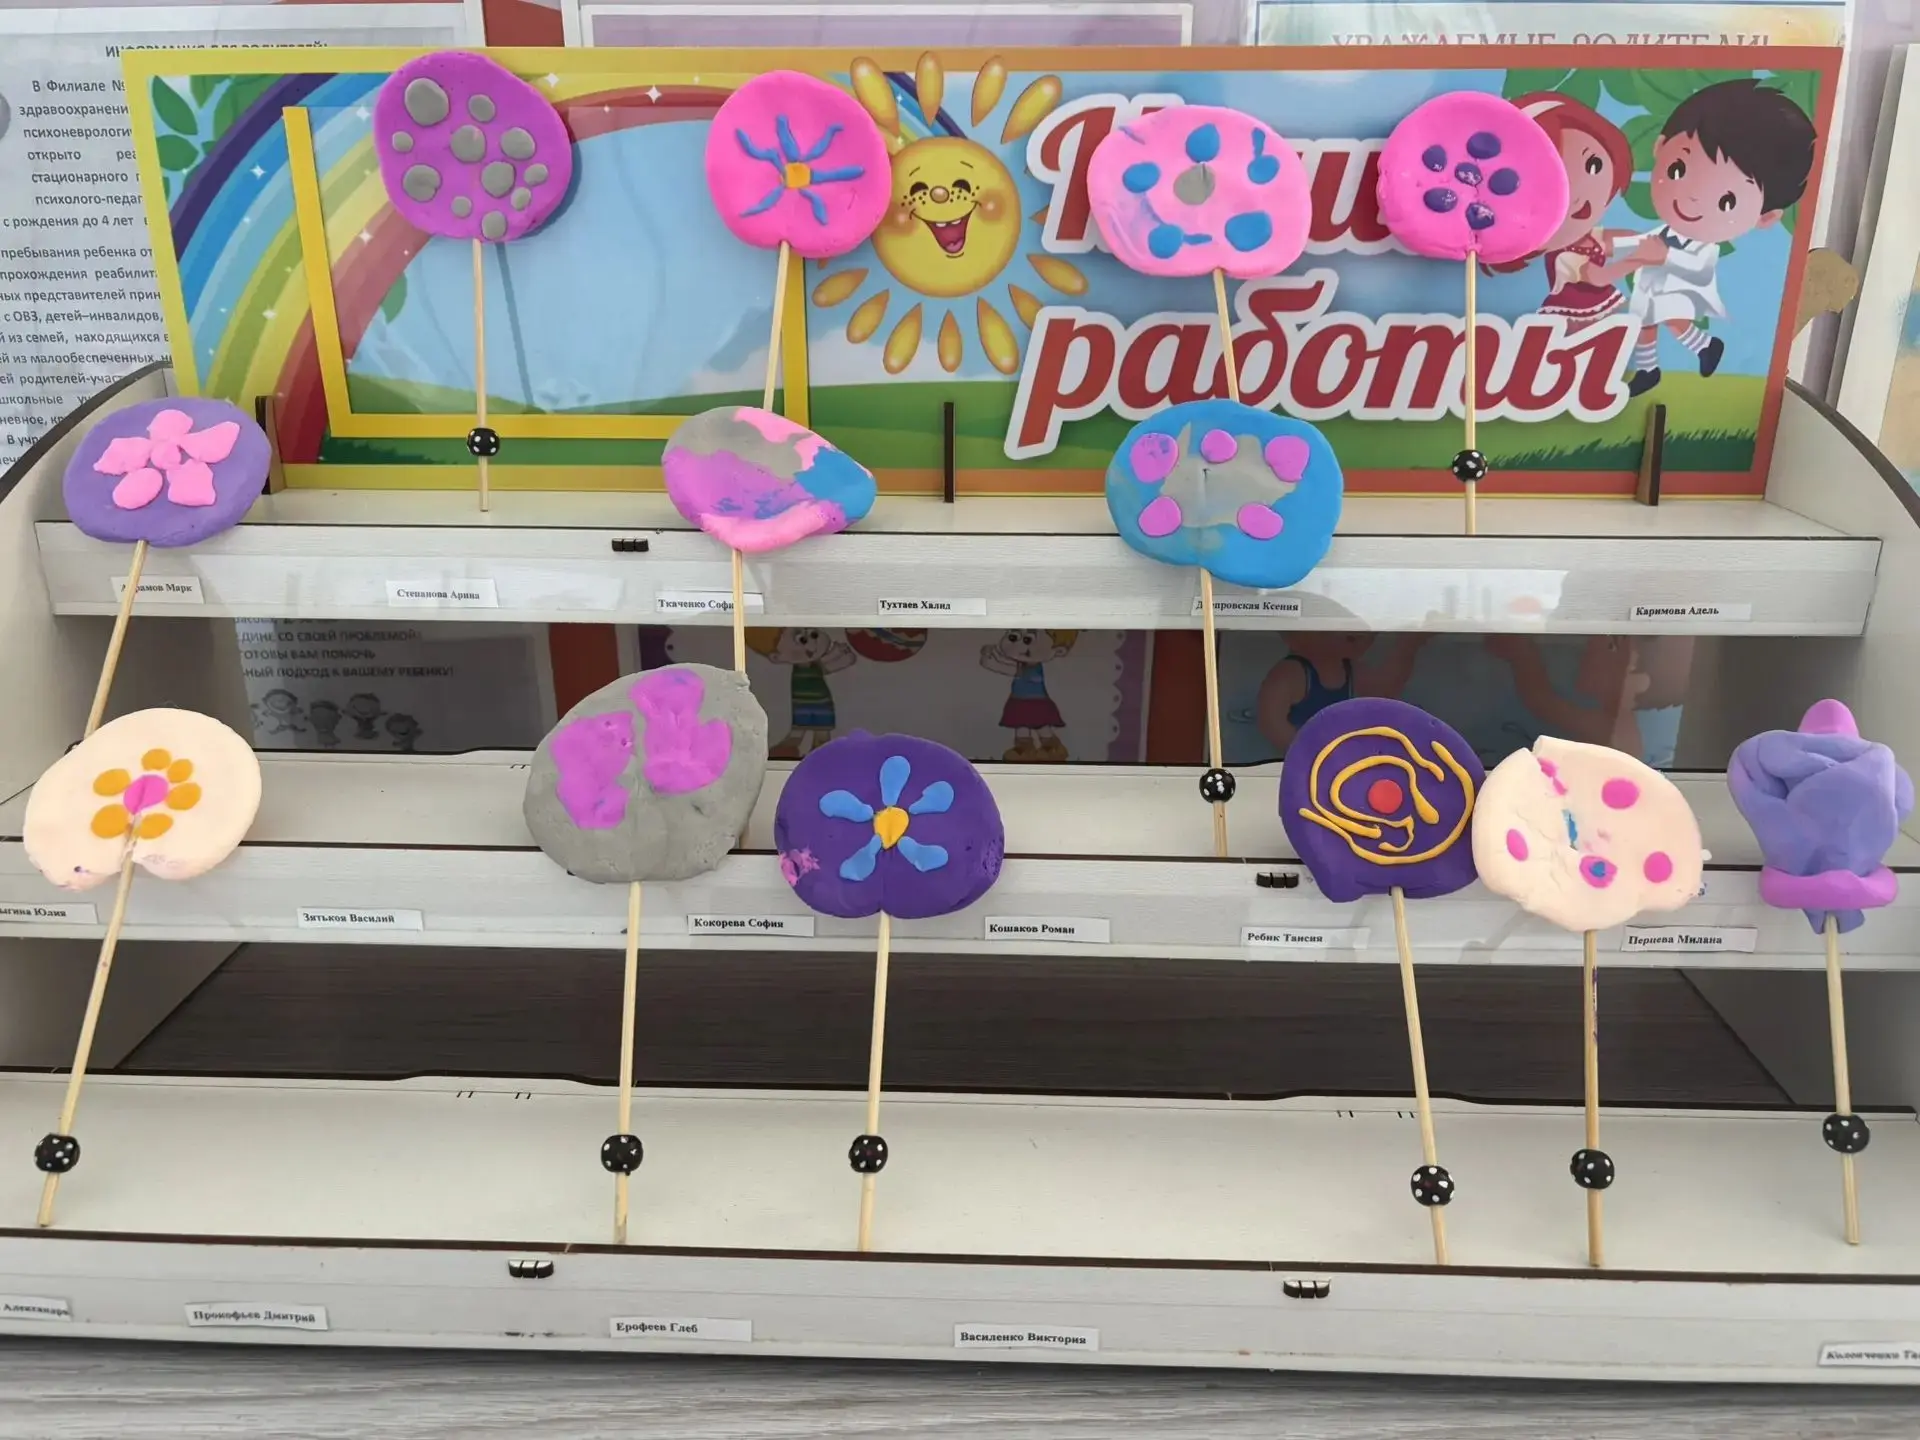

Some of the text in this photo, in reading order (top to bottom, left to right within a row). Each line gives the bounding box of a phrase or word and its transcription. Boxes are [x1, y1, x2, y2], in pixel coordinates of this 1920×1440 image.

[32, 80, 41, 92] В
[46, 80, 106, 92] Филиале
[27, 150, 82, 162] открыто
[31, 173, 128, 185] стационарного
[13, 216, 79, 229] рождения
[82, 216, 98, 228] до
[101, 215, 109, 225] 4
[112, 216, 134, 226] лет
[0, 247, 80, 260] пребывания
[83, 246, 137, 260] ребенка
[24, 289, 126, 303] представителей
[13, 311, 42, 324] ОВЗ,
[8, 334, 23, 343] из
[25, 331, 69, 345] семей,
[75, 333, 160, 345] находящихся
[13, 355, 27, 363] из
[1010, 273, 1634, 454] работы
[7, 435, 15, 445] В
[165, 583, 193, 593] Марк
[397, 589, 480, 600] Степанова Арина
[658, 599, 706, 608] Ткаченко
[880, 600, 951, 610] Тухтаев Халид
[1195, 601, 1299, 611] Дпровская Ксения
[1636, 606, 1719, 617] Каримова Адель
[34, 908, 67, 917] Юлия
[350, 913, 395, 923] Василий
[694, 918, 784, 930] Кокорева София
[989, 924, 1075, 934] Кошаков Роман
[1248, 932, 1323, 942] Ребик Таисия
[1677, 935, 1722, 945] Милана
[193, 1311, 316, 1323] Прокофьев Дмитрий
[616, 1322, 699, 1333] Ерофеев Глеб
[960, 1332, 1087, 1345] Василенко Виктория
